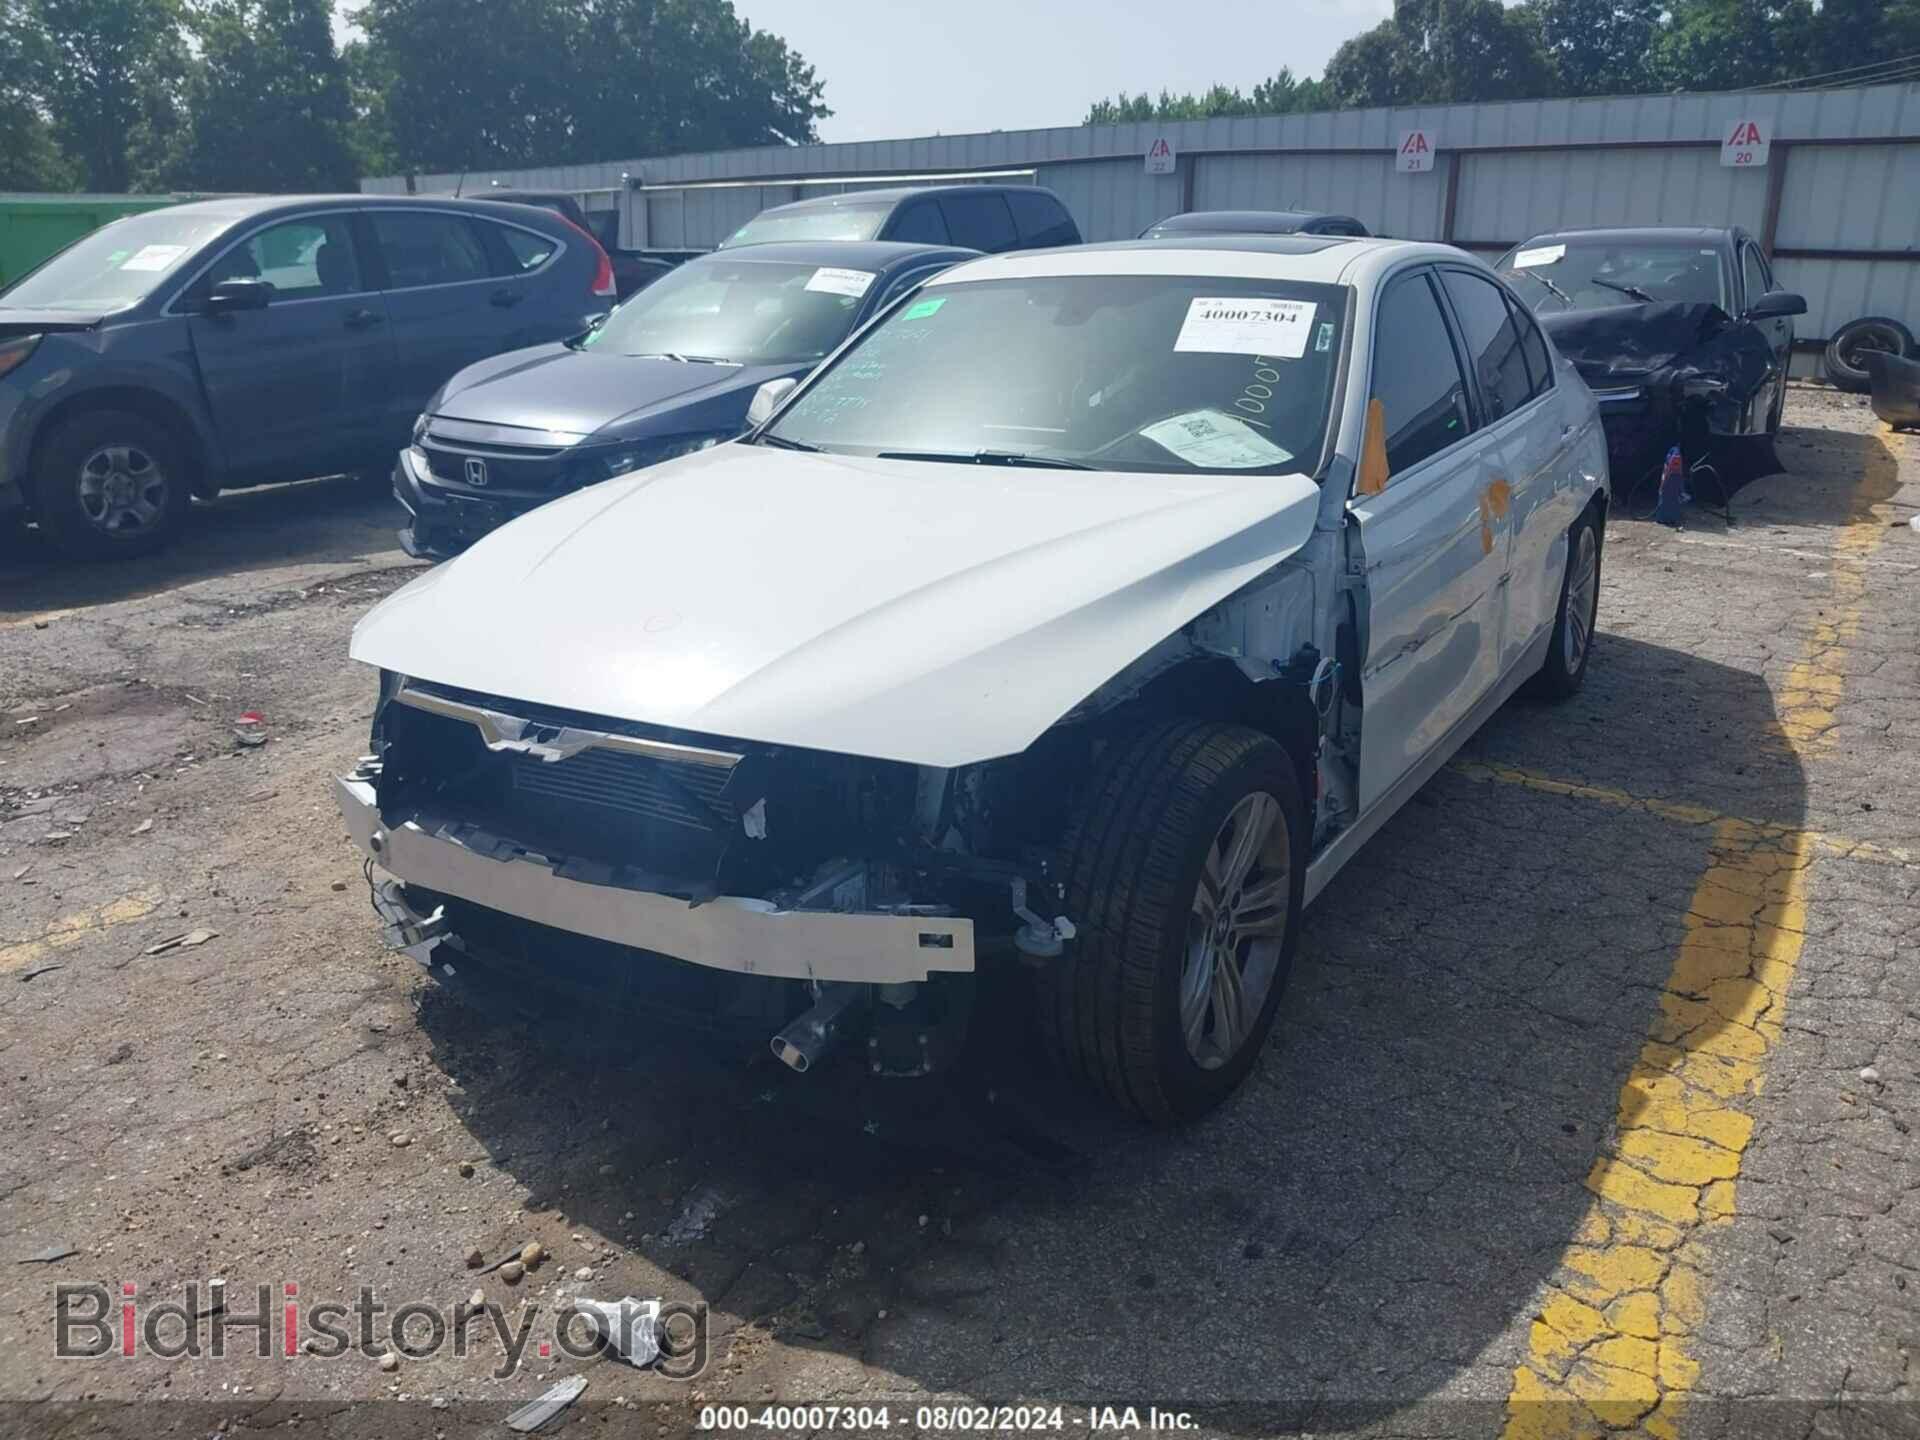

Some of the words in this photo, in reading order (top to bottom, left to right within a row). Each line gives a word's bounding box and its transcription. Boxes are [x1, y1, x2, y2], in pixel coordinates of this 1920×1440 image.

[1407, 159, 1421, 170] 21
[1735, 152, 1753, 165] 20
[1199, 309, 1298, 324] 40007304
